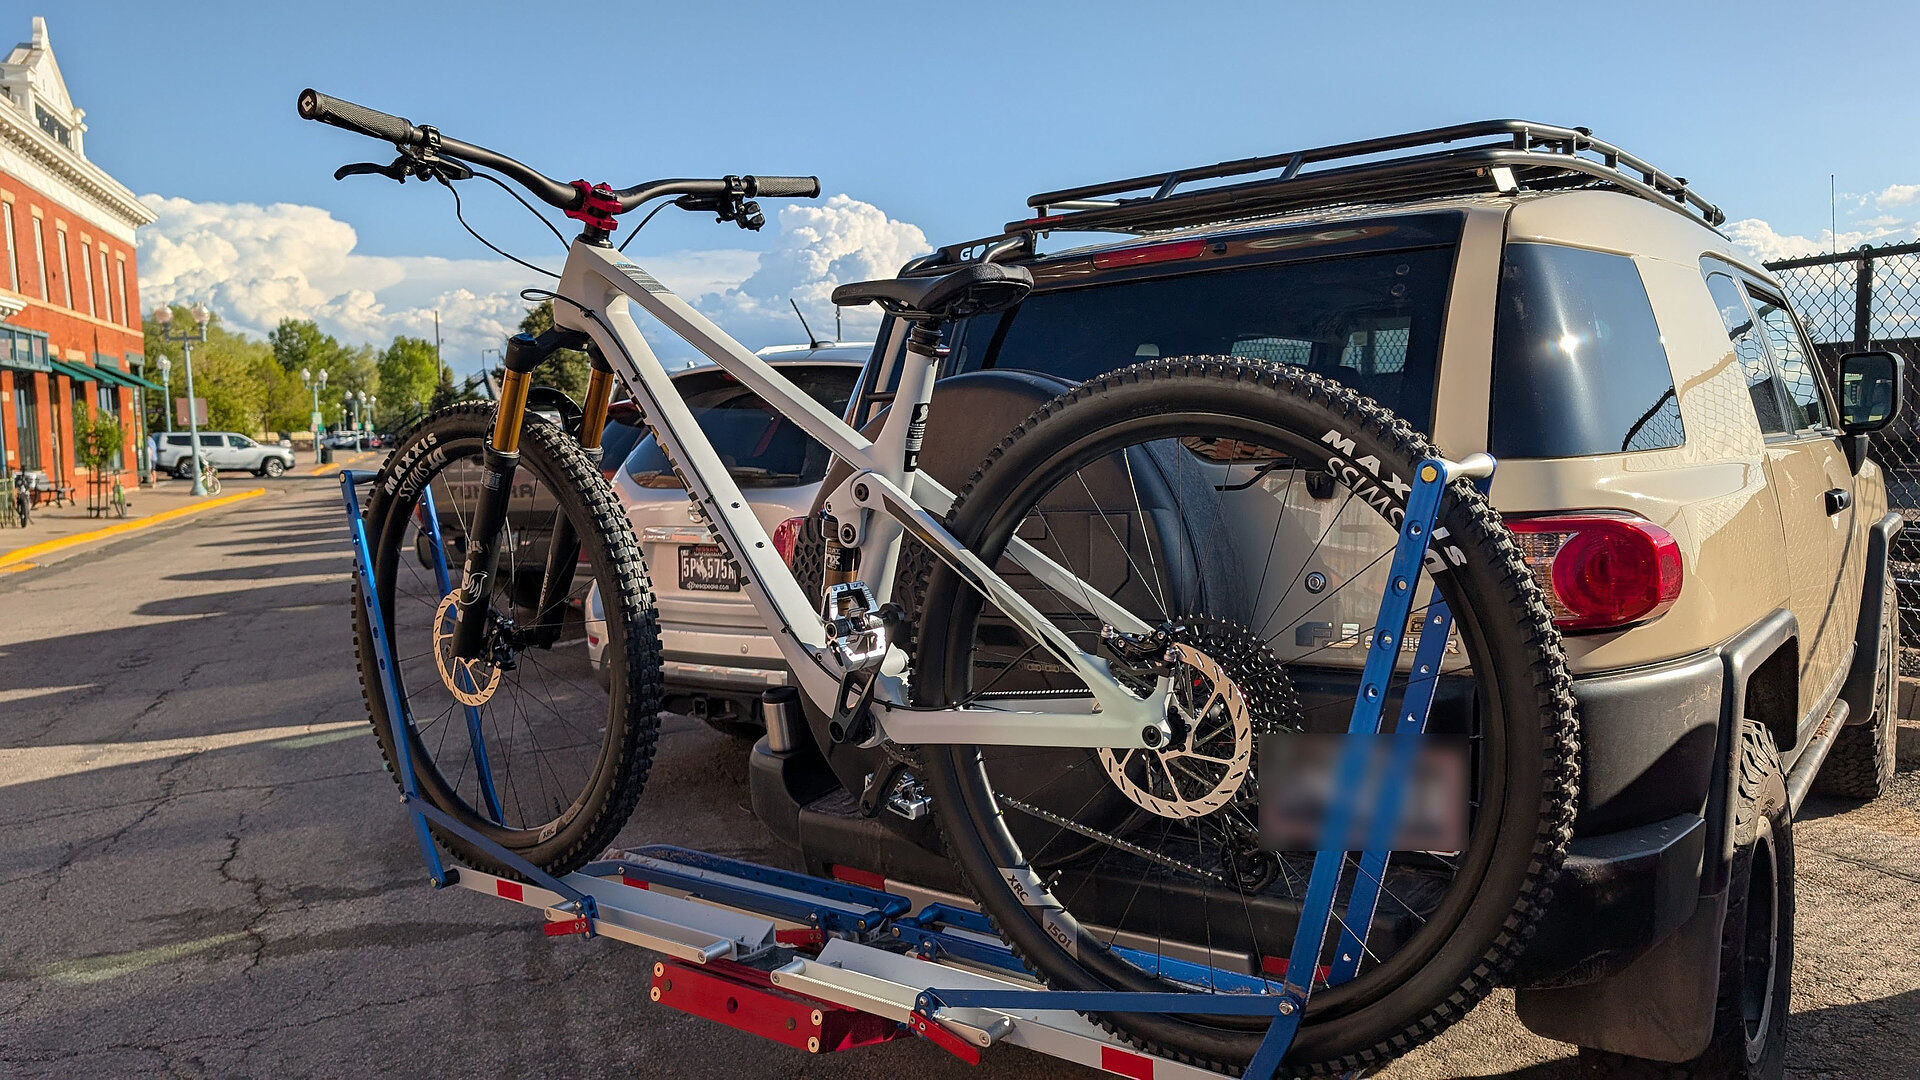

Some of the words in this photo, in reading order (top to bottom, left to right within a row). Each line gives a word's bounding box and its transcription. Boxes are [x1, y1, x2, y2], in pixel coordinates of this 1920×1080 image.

[384, 432, 437, 496] MAXXIS
[427, 446, 448, 471] DT
[399, 461, 430, 502] SWISS
[1321, 429, 1468, 566] MAXIS
[1325, 456, 1406, 527] SWISS
[1295, 621, 1360, 649] FJ
[1007, 874, 1029, 902] XRC
[1047, 921, 1072, 948] 1501
